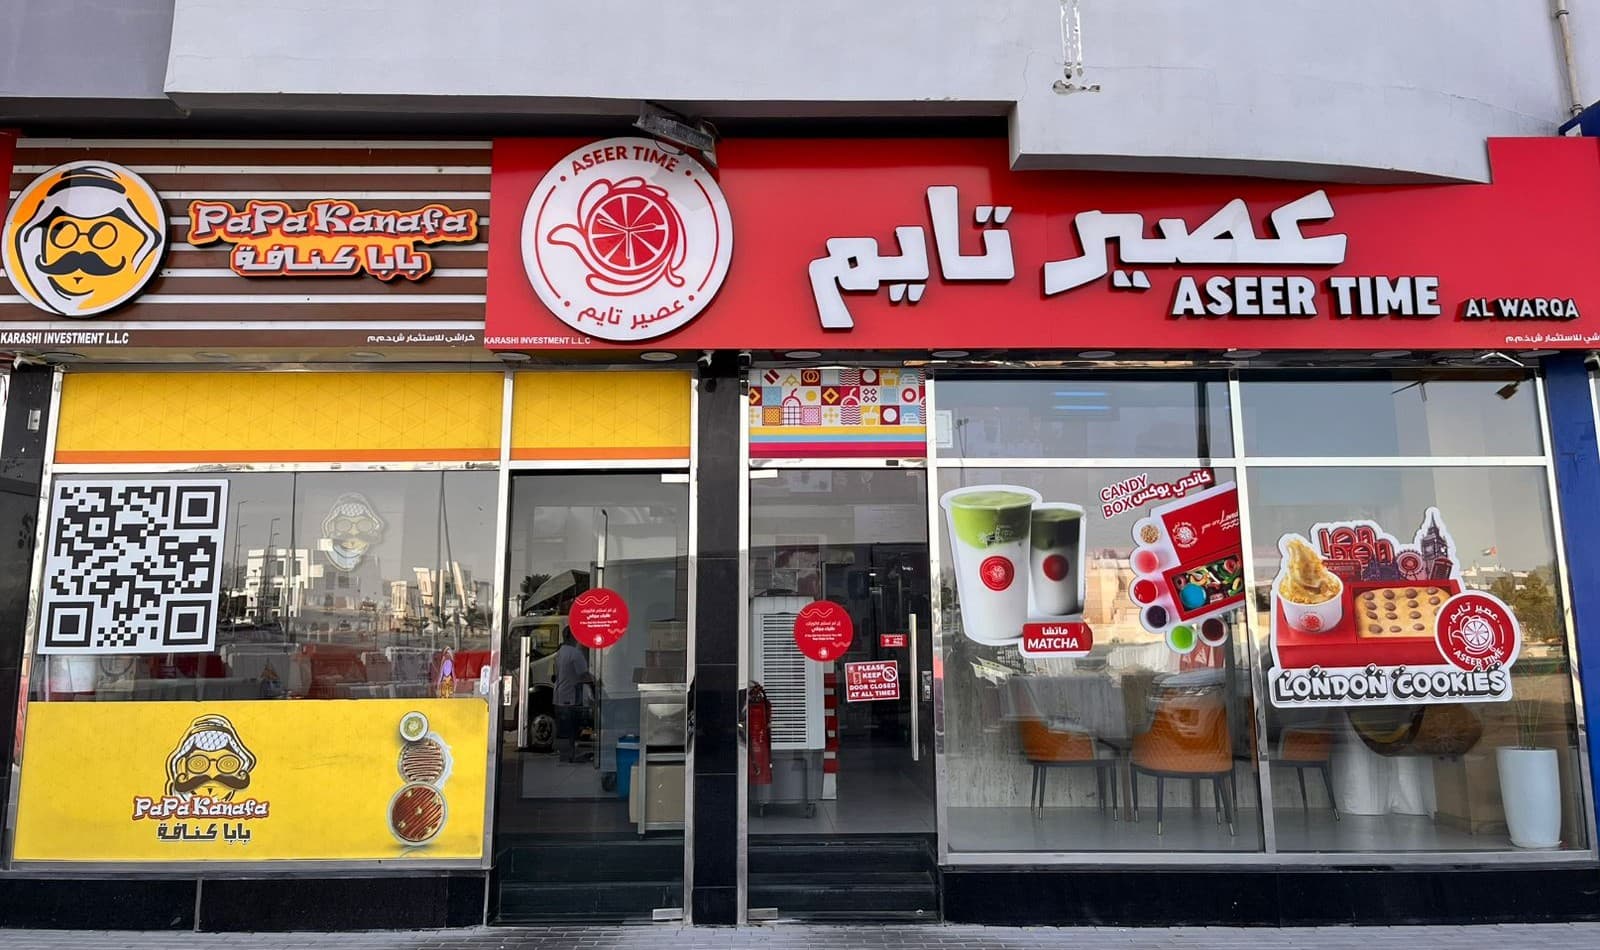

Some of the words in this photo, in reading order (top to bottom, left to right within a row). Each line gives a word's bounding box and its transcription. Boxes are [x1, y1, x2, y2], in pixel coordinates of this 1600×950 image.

[571, 145, 628, 176] ASEER
[632, 146, 680, 173] TIME
[311, 200, 468, 235] Kanafa
[1044, 188, 1348, 296] عصير
[235, 244, 360, 271] كنافة
[366, 244, 424, 278] بابا
[808, 185, 1015, 328] تايم
[1171, 275, 1317, 316] ASEER
[1330, 275, 1441, 316] TIME
[577, 305, 623, 326] تايم
[630, 299, 685, 330] عصير
[1464, 298, 1493, 318] AL
[1500, 298, 1580, 318] WARQA
[0, 331, 41, 344] KARASHI
[44, 331, 104, 344] INVESTMENT
[106, 331, 129, 344] L.L.C
[484, 336, 519, 345] KARASHI
[520, 336, 570, 345] INVESTMENT
[571, 336, 591, 345] L.L.C
[1101, 474, 1148, 501] CANDY
[1133, 484, 1171, 504] بوكس
[1173, 470, 1211, 496] كاندي
[1102, 497, 1133, 518] BOX
[1041, 625, 1069, 637] ماتشا
[1027, 637, 1079, 650] MATCHA
[1453, 650, 1482, 667] ASEER
[1482, 647, 1505, 665] TIME
[869, 682, 896, 690] CLOSED
[875, 689, 896, 697] TIMES
[1275, 671, 1388, 699] LONDON
[1392, 668, 1507, 699] COOKIES
[192, 796, 268, 818] Kanafa
[157, 822, 217, 841] كنافة
[223, 823, 251, 845] بابا
